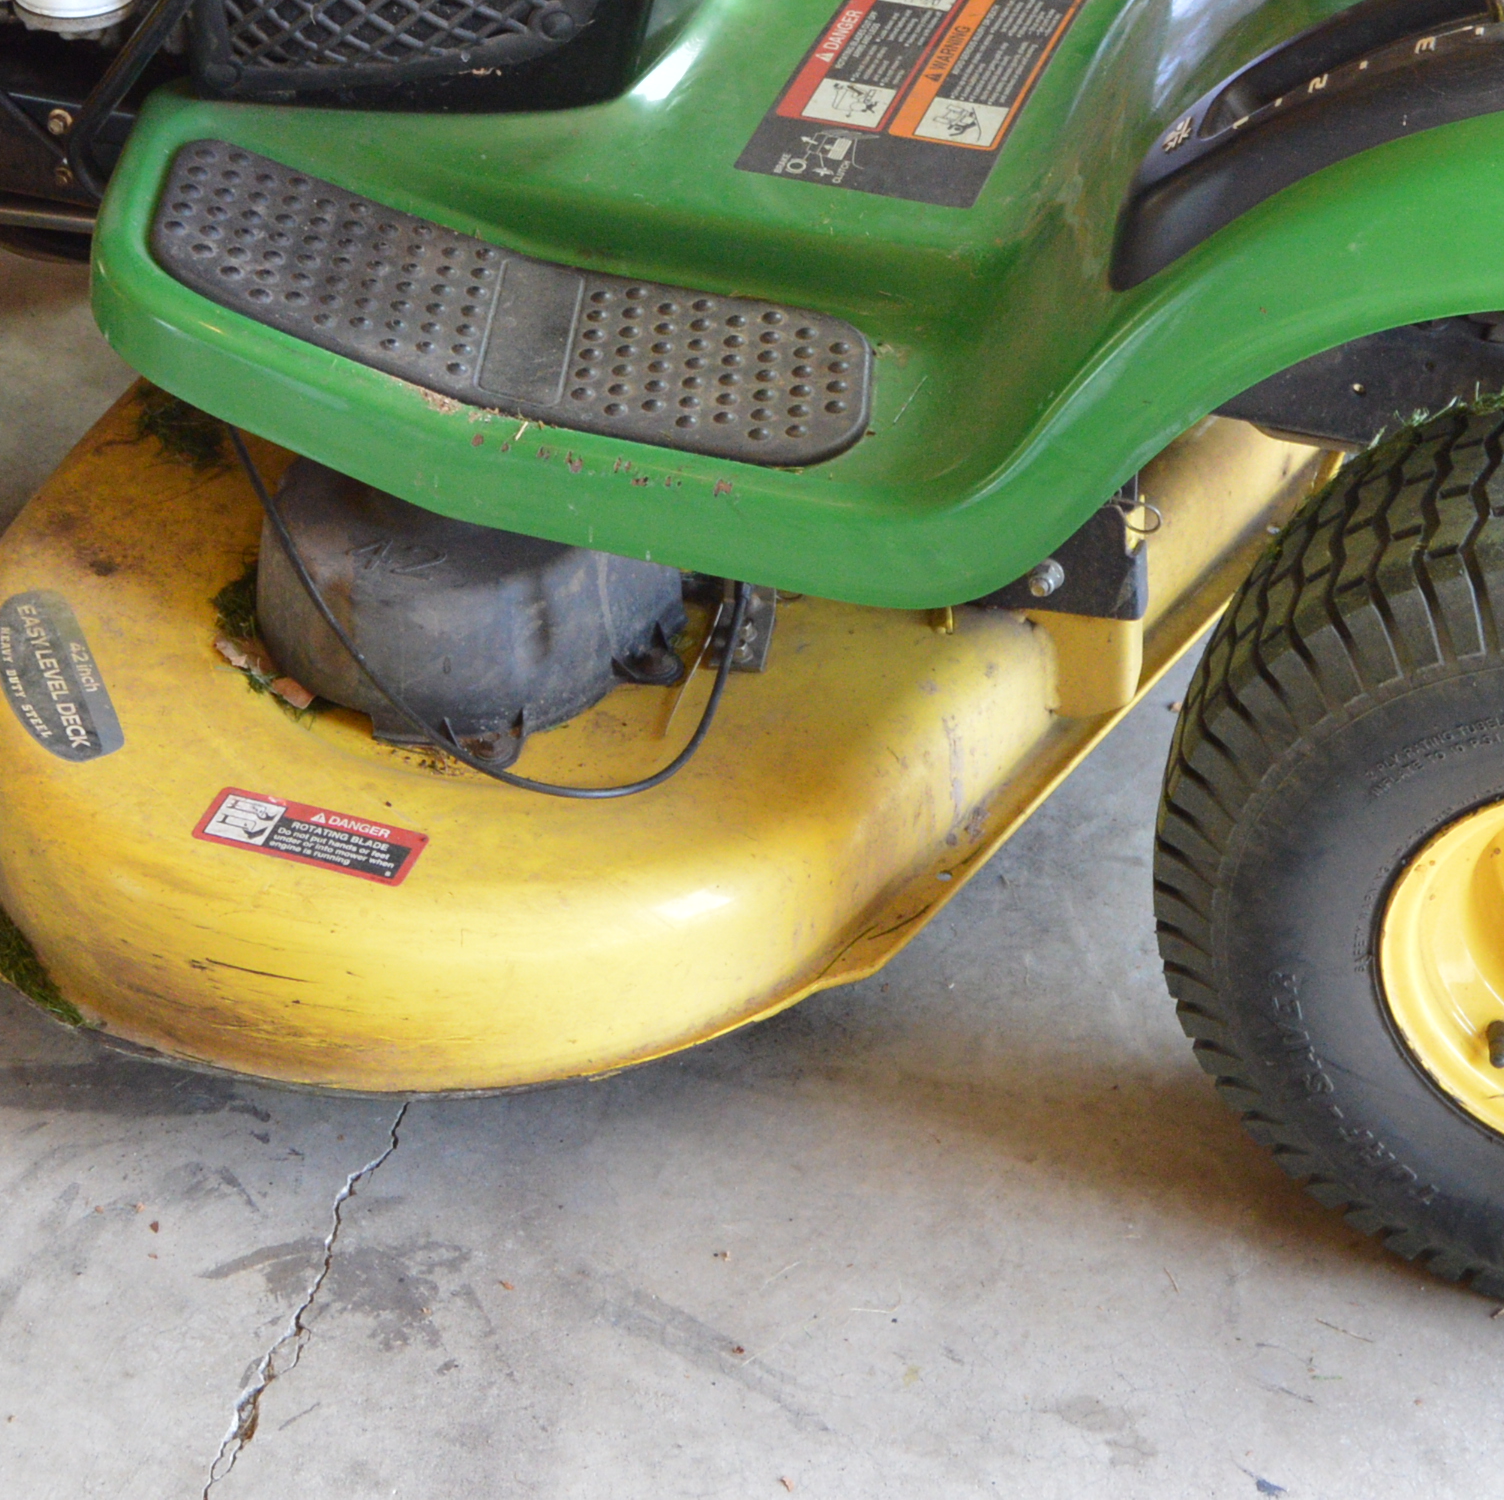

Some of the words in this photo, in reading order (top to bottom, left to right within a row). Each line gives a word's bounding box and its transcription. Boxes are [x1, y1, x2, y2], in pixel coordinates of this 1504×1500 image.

[823, 9, 863, 52] DANGER
[930, 25, 971, 70] WARNING
[831, 160, 851, 184] CLUTCH
[0, 626, 15, 664] HEAVY
[69, 641, 90, 663] 42
[5, 669, 28, 699] DUTY
[16, 603, 52, 651] EASY
[34, 648, 70, 701] LEVEL
[55, 701, 93, 749] DECK
[76, 662, 102, 693] inch
[21, 703, 55, 739] STEEL
[291, 821, 350, 842] ROTATING
[349, 834, 390, 852] BLADE
[328, 815, 392, 840] DANGER
[269, 840, 302, 853] engine
[302, 846, 312, 855] is
[312, 850, 352, 866] running
[273, 834, 302, 846] under
[302, 840, 315, 849] or
[314, 843, 335, 854] into
[335, 848, 369, 862] mower
[368, 856, 396, 870] when
[277, 827, 292, 836] Do
[293, 831, 309, 841] not
[310, 834, 328, 846] put
[328, 838, 358, 852] hands
[358, 847, 371, 856] or
[371, 848, 391, 861] feet
